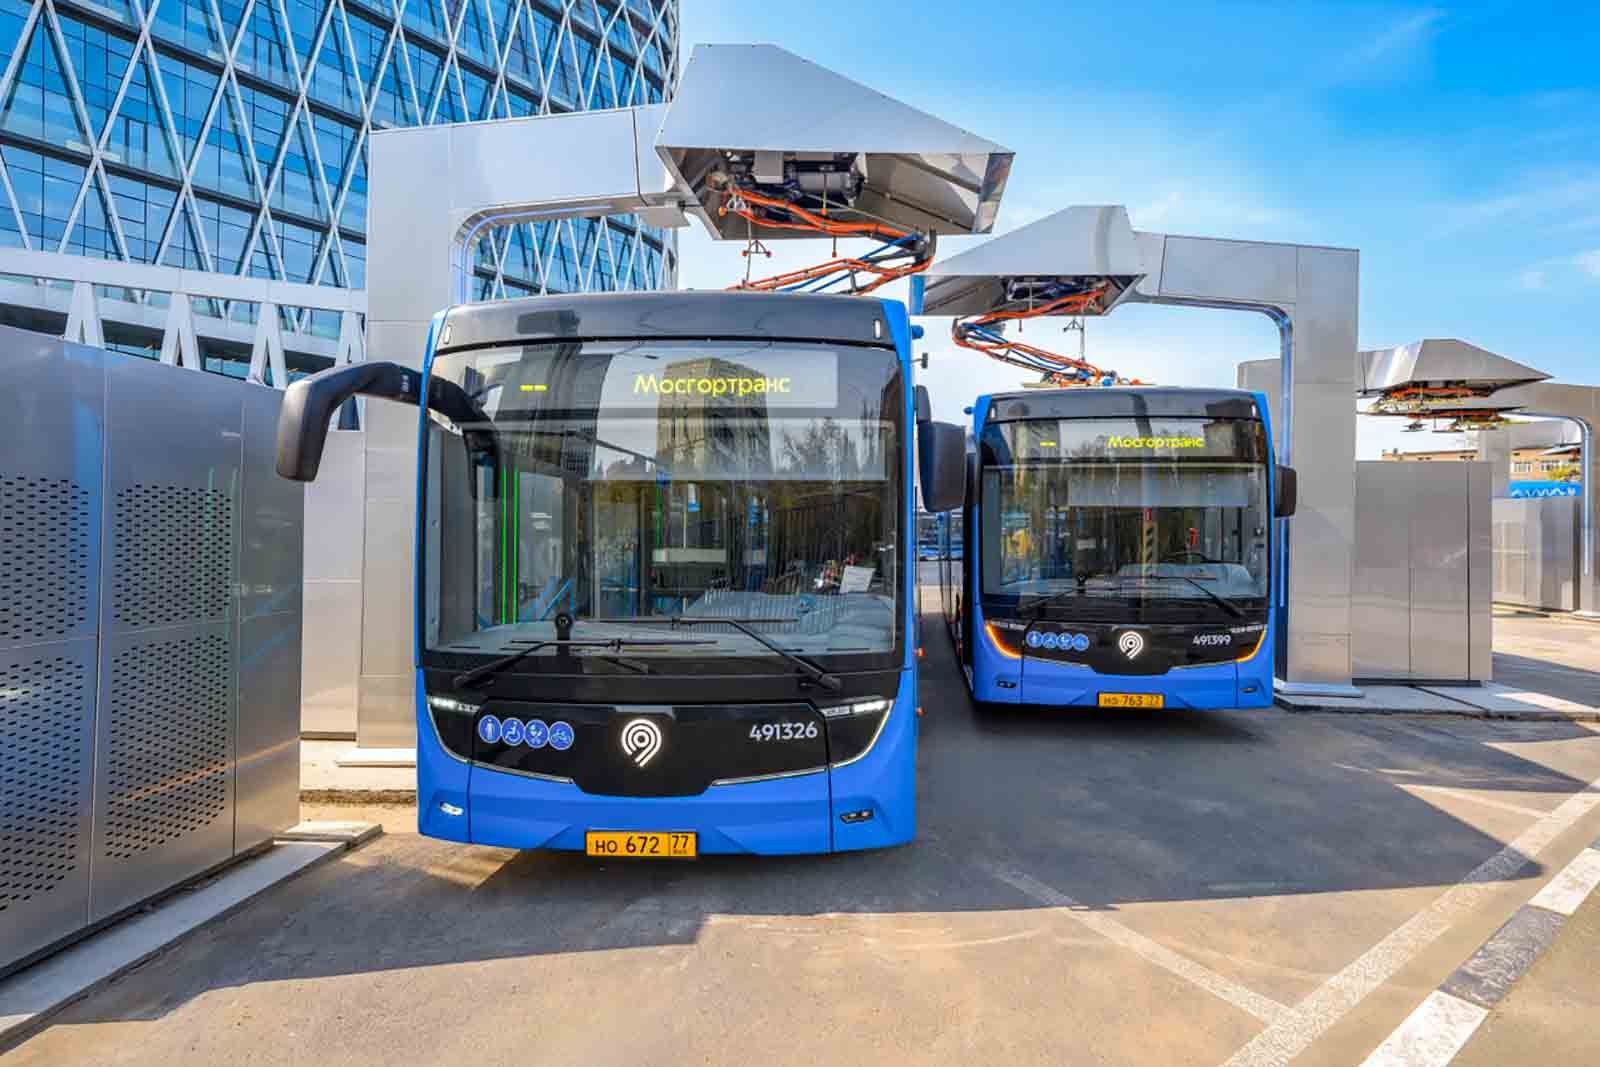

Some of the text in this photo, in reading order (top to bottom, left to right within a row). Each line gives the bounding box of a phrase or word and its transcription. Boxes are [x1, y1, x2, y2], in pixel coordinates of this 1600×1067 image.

[633, 374, 791, 397] Мосгортранс
[1107, 436, 1205, 449] Мосгортранс
[1192, 634, 1231, 645] 491399
[749, 721, 818, 741] 491326
[625, 835, 660, 854] 672
[671, 835, 689, 848] 77
